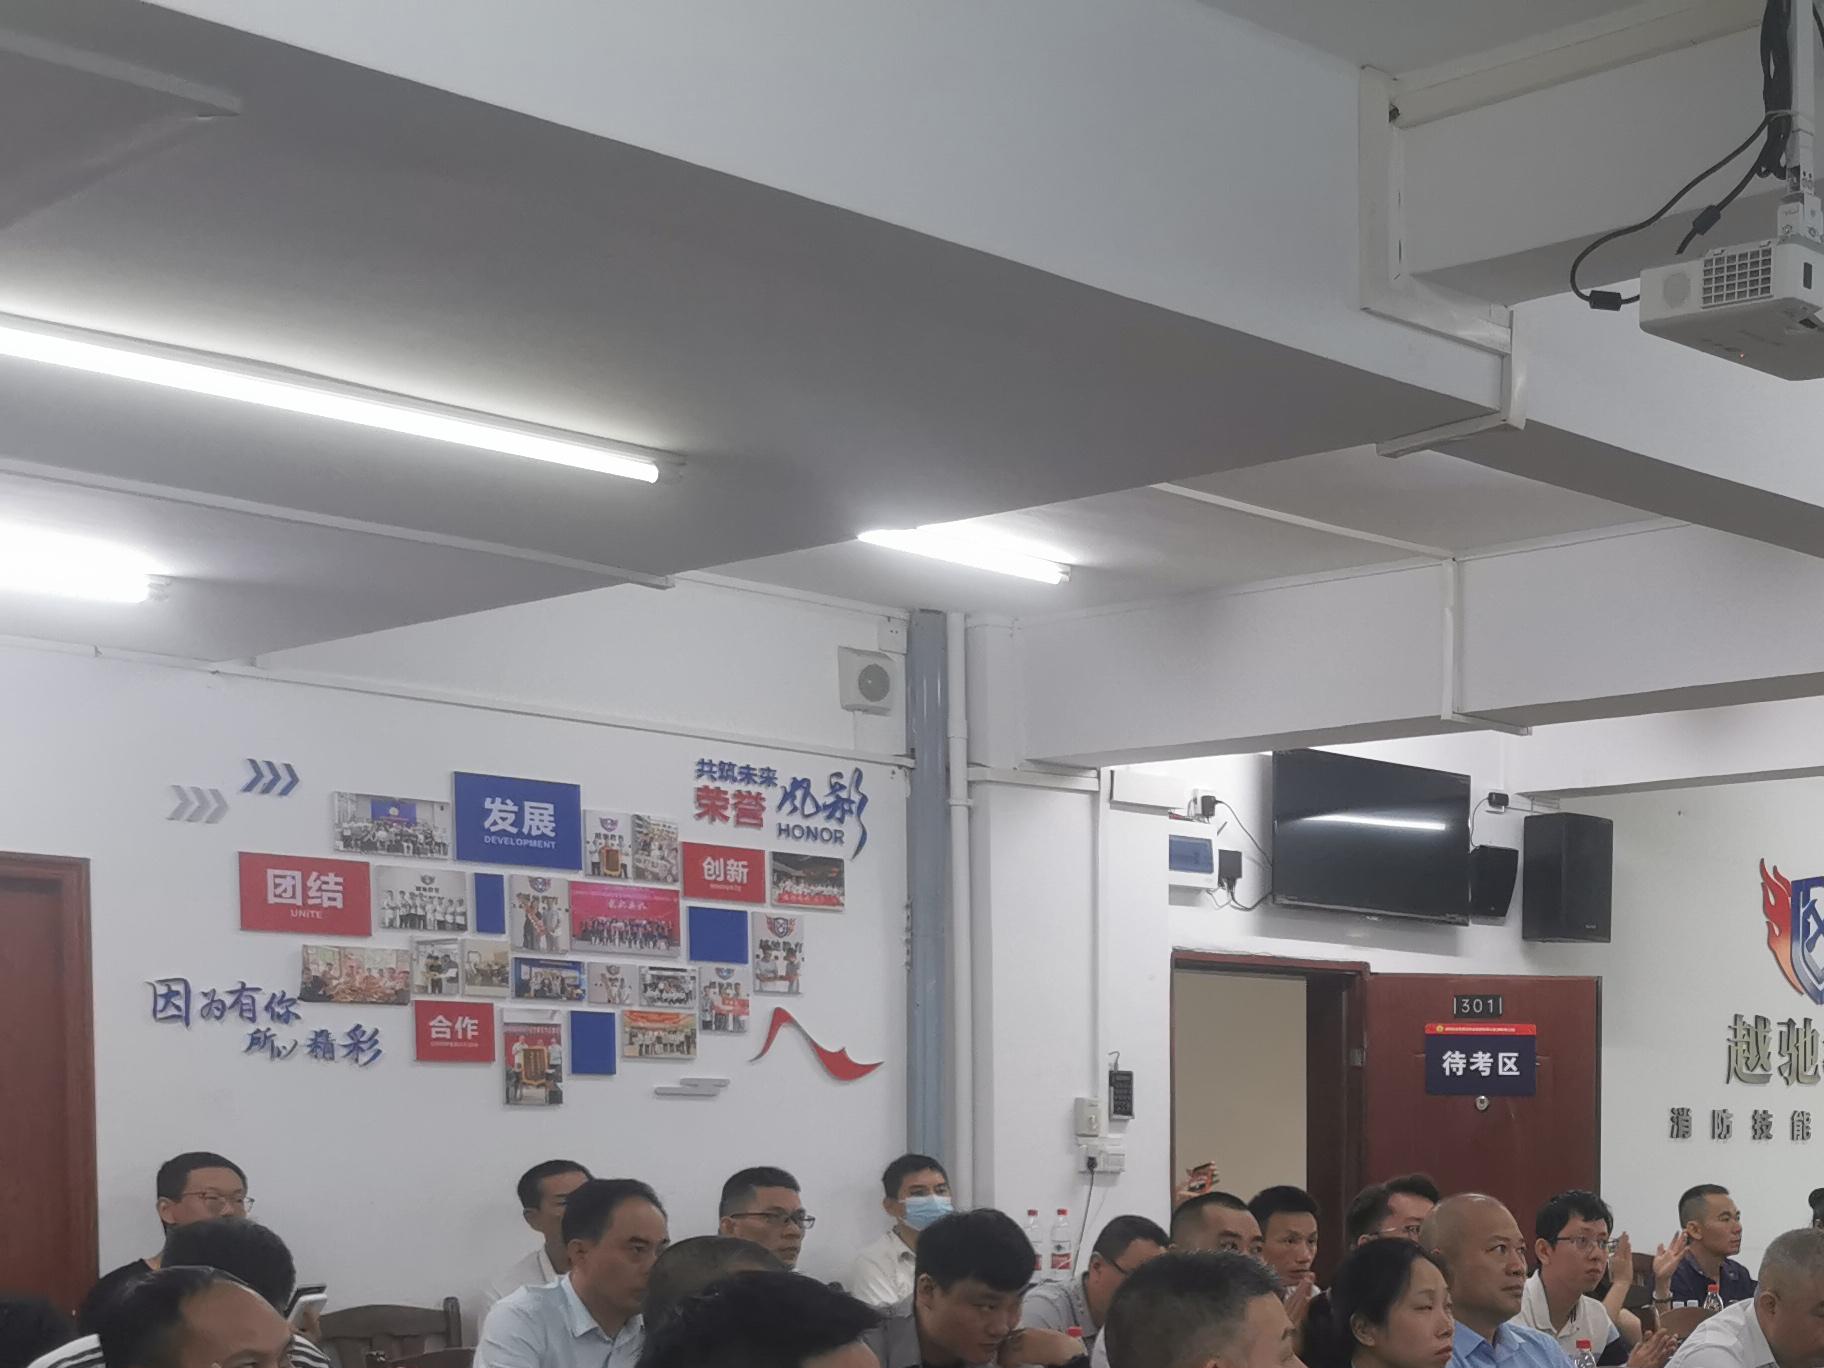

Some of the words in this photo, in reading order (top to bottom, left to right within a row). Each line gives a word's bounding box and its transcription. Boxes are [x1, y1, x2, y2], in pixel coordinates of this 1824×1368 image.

[695, 758, 778, 789] 共筑未来
[483, 797, 557, 838] 发展
[694, 784, 766, 829] 荣誉
[483, 835, 556, 850] DEVELOPMENT
[777, 822, 845, 845] HONOR
[703, 856, 749, 885] 创新
[266, 868, 344, 909] 团结
[290, 909, 323, 920] UNITE
[146, 977, 302, 1030] 因为有你
[1461, 998, 1494, 1014] 301
[429, 1014, 480, 1040] 合作
[243, 1023, 383, 1067] 所以精彩
[1442, 1050, 1521, 1077] 待考区
